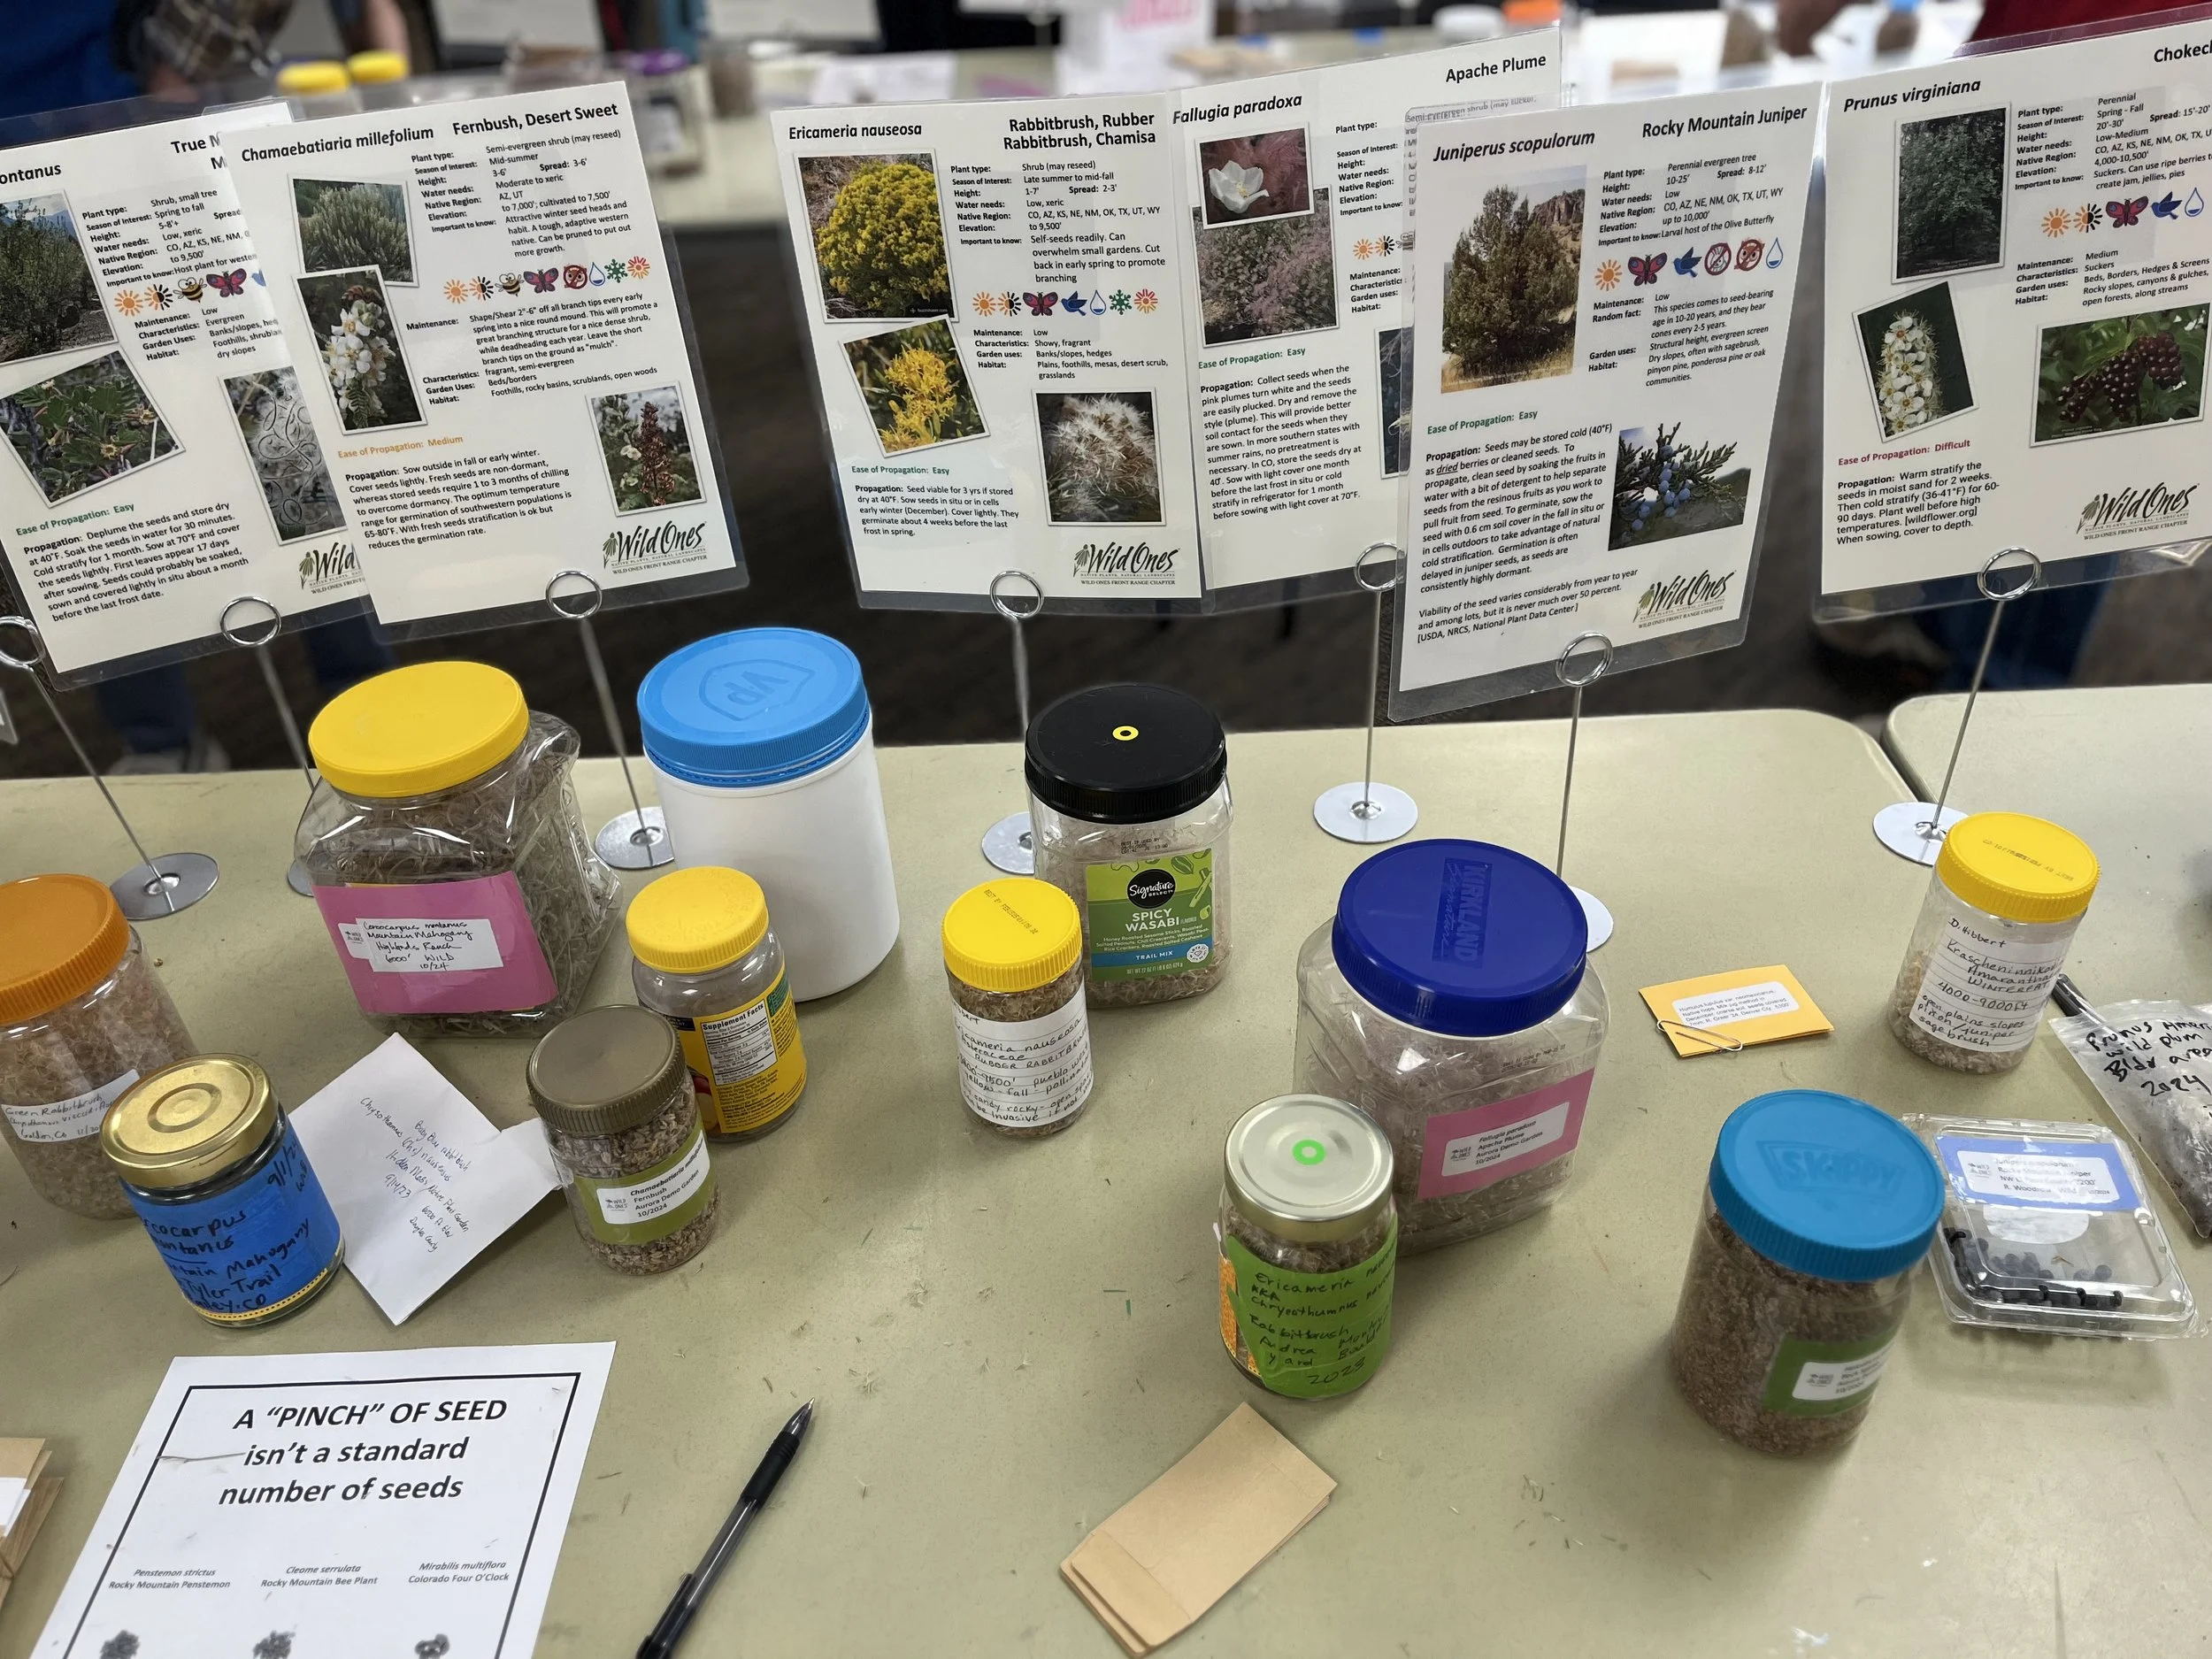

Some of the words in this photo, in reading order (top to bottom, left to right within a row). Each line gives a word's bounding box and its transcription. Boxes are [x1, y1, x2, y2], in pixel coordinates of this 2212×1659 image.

[1446, 63, 1498, 84] Apache
[1502, 56, 1546, 73] Plume
[1844, 94, 1898, 112] Prunus
[1902, 81, 1981, 103] virginiana
[2098, 92, 2136, 107] Perennial
[1172, 104, 1229, 124] Fallugia
[1233, 96, 1302, 119] paradoxa
[1010, 114, 1098, 132] Rabbitbrush,
[1102, 112, 1155, 127] Rubber
[1642, 119, 1685, 138] Rocky
[1687, 111, 1755, 133] Mountain
[1757, 106, 1808, 124] Juniper
[242, 136, 352, 162] Chamaebatiaria
[356, 127, 434, 147] millefolium
[452, 115, 523, 135] Fernbush,
[525, 110, 572, 126] Desert
[574, 104, 618, 119] Sweet
[789, 124, 857, 140] Ericameria
[862, 125, 922, 137] nauseosa
[1003, 133, 1092, 150] Rabbitbrush,
[1096, 130, 1156, 145] Chamisa
[170, 140, 207, 153] True
[1432, 142, 1506, 162] Juniperus
[1509, 133, 1595, 154] scopulorum
[1047, 163, 1065, 172] (may
[1067, 160, 1095, 170] reseed)
[1668, 159, 1702, 172] Perennial
[1703, 157, 1740, 168] evergreen
[495, 176, 534, 188] Moderate
[545, 173, 564, 183] xeric
[1085, 172, 1114, 181] mid-fall
[1069, 185, 1099, 195] Spread:
[82, 209, 107, 219] Plant
[106, 206, 127, 216] type:
[150, 196, 177, 207] Shrub,
[179, 191, 200, 202] small
[154, 209, 180, 219] Spring
[192, 203, 204, 211] fall
[102, 262, 143, 277] Elevation:
[1035, 273, 1077, 283] branching
[205, 313, 245, 327] Evergreen
[1218, 357, 1227, 366] of
[1230, 351, 1283, 365] Propagation:
[1646, 373, 1692, 387] communities.
[1427, 426, 1447, 434] Ease
[1449, 421, 1459, 431] of
[1460, 414, 1514, 429] Propagation:
[1519, 411, 1538, 420] Easy
[337, 448, 357, 459] Ease
[370, 442, 424, 454] Propagation:
[427, 437, 463, 446] Medium
[1861, 454, 1870, 463] of
[1872, 448, 1930, 461] Propagation:
[1935, 440, 1970, 452] Difficult
[880, 466, 928, 475] Propagation:
[933, 467, 949, 476] Easy
[2098, 488, 2149, 524] Wild
[2143, 482, 2198, 518] Ones
[16, 526, 38, 535] Ease
[40, 521, 49, 530] of
[50, 506, 110, 529] Propagation:
[113, 503, 134, 513] Easy
[618, 529, 657, 563] Wild
[659, 521, 704, 553] Ones
[1088, 541, 1134, 573] Wild
[1131, 542, 1179, 573] Ones
[1647, 575, 1696, 615] Wild
[1687, 570, 1734, 605] Ones
[1129, 881, 1174, 899] Signature
[1133, 908, 1172, 922] SPICY
[1455, 863, 1493, 963] KIRKLAND
[1125, 918, 1179, 932] WASABI
[1948, 918, 1960, 929] D.
[415, 931, 472, 941] Mahogany
[426, 953, 455, 962] WILD
[703, 1013, 746, 1031] Supplement
[747, 1003, 764, 1016] Facts
[2085, 1021, 2153, 1051] Prunus
[2141, 1074, 2212, 1097] 2024
[1476, 1148, 1498, 1157] Aurora
[1501, 1141, 1518, 1150] Demo
[1520, 1132, 1543, 1143] Garden
[1478, 1140, 1502, 1150] Apache
[1504, 1133, 1525, 1142] Plume
[1475, 1154, 1501, 1164] 10/2024
[630, 1167, 684, 1196] Chamaebatiaria
[635, 1199, 660, 1210] Aurora
[662, 1187, 680, 1201] Demo
[681, 1170, 699, 1189] Garden
[634, 1187, 667, 1203] Fernbush
[637, 1203, 667, 1217] 10/2024
[232, 1409, 254, 1429] A
[390, 1402, 431, 1424] OF
[434, 1400, 507, 1422] SEED
[312, 1447, 330, 1463] a
[337, 1436, 470, 1462] standard
[219, 1479, 336, 1505] number
[342, 1477, 377, 1501] of
[379, 1475, 464, 1500] seeds
[320, 1564, 361, 1573] serrulata
[419, 1562, 459, 1571] Mirabilis
[461, 1561, 507, 1571] multiflora
[109, 1581, 135, 1590] Rocky
[180, 1578, 231, 1590] Penstemon
[261, 1578, 288, 1588] Rocky
[289, 1578, 333, 1586] Mountain
[408, 1575, 449, 1584] Colorado
[452, 1574, 473, 1583] Four
